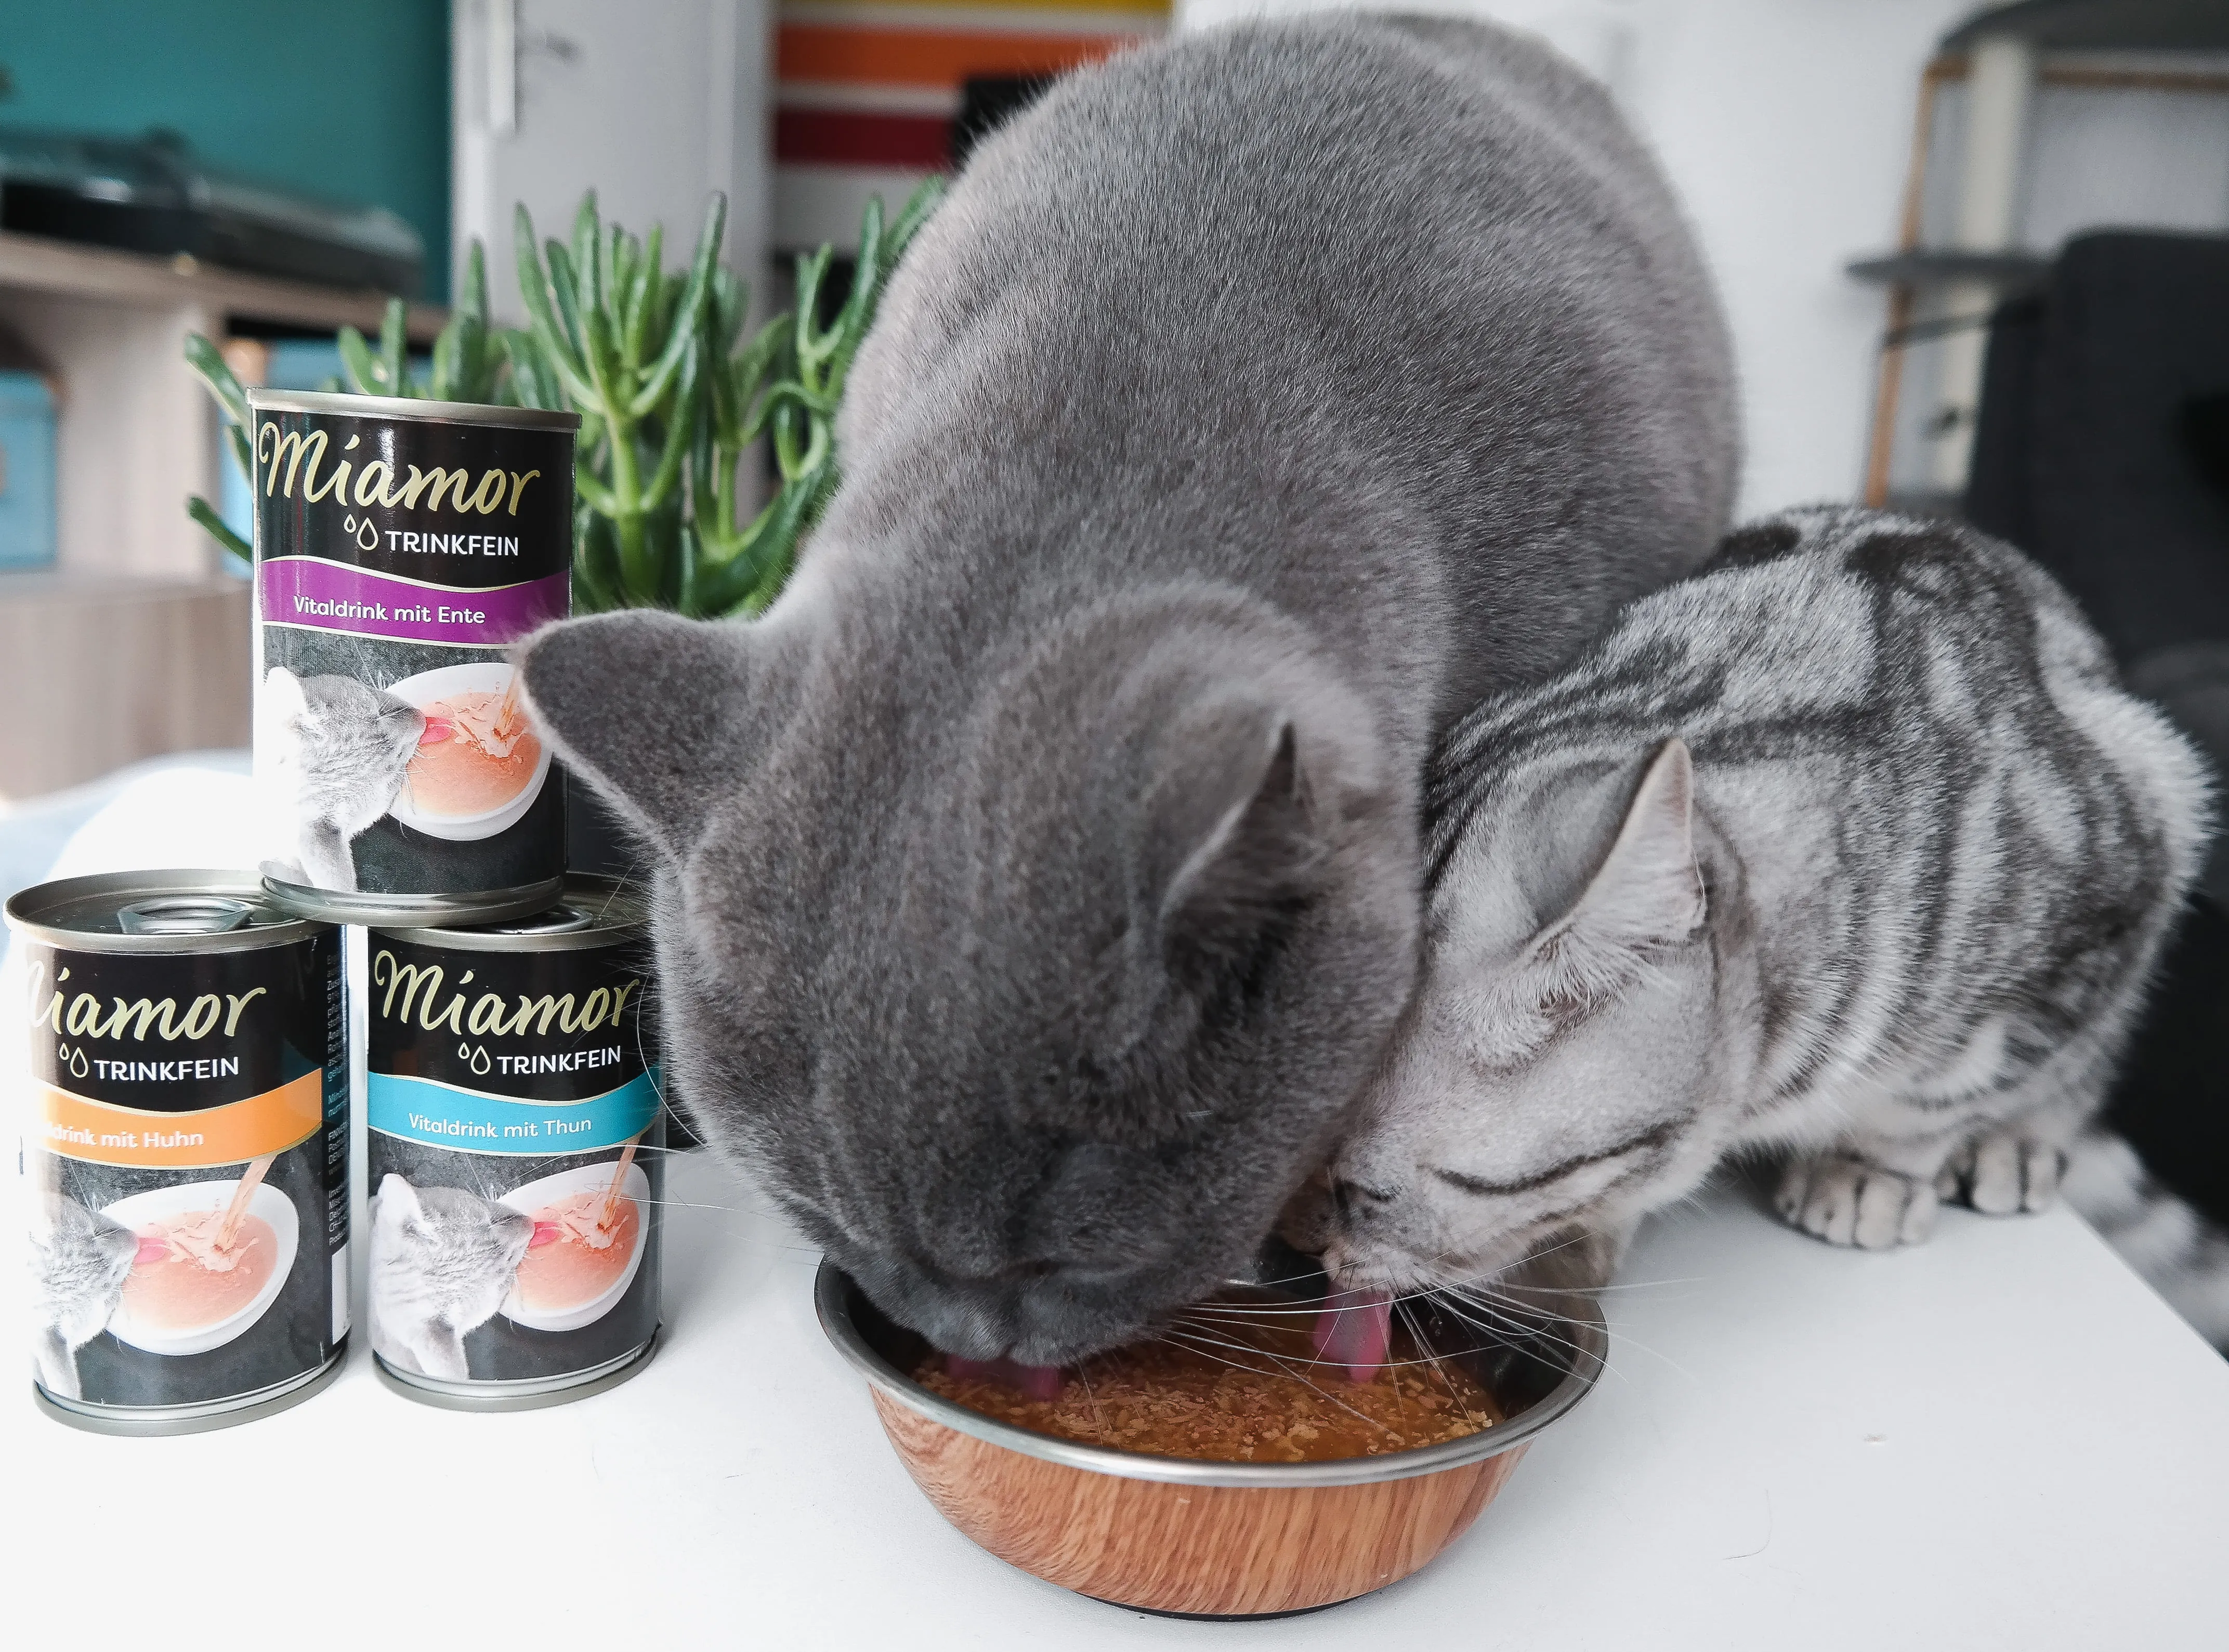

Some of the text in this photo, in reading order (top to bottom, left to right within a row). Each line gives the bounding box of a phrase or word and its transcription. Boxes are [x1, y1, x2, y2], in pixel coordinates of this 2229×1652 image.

[259, 422, 540, 516] Miamor
[385, 530, 519, 557] TRINKFEIN
[293, 595, 486, 624] Vitaldrink mit Ente
[374, 950, 639, 1036] Miamor
[94, 1056, 239, 1081] TRINKFEIN
[496, 1045, 621, 1074] TRINKFEIN
[409, 1112, 592, 1138] Vitaldrink mit Thun
[101, 1131, 138, 1148] mit
[142, 1131, 204, 1148] Huhn
